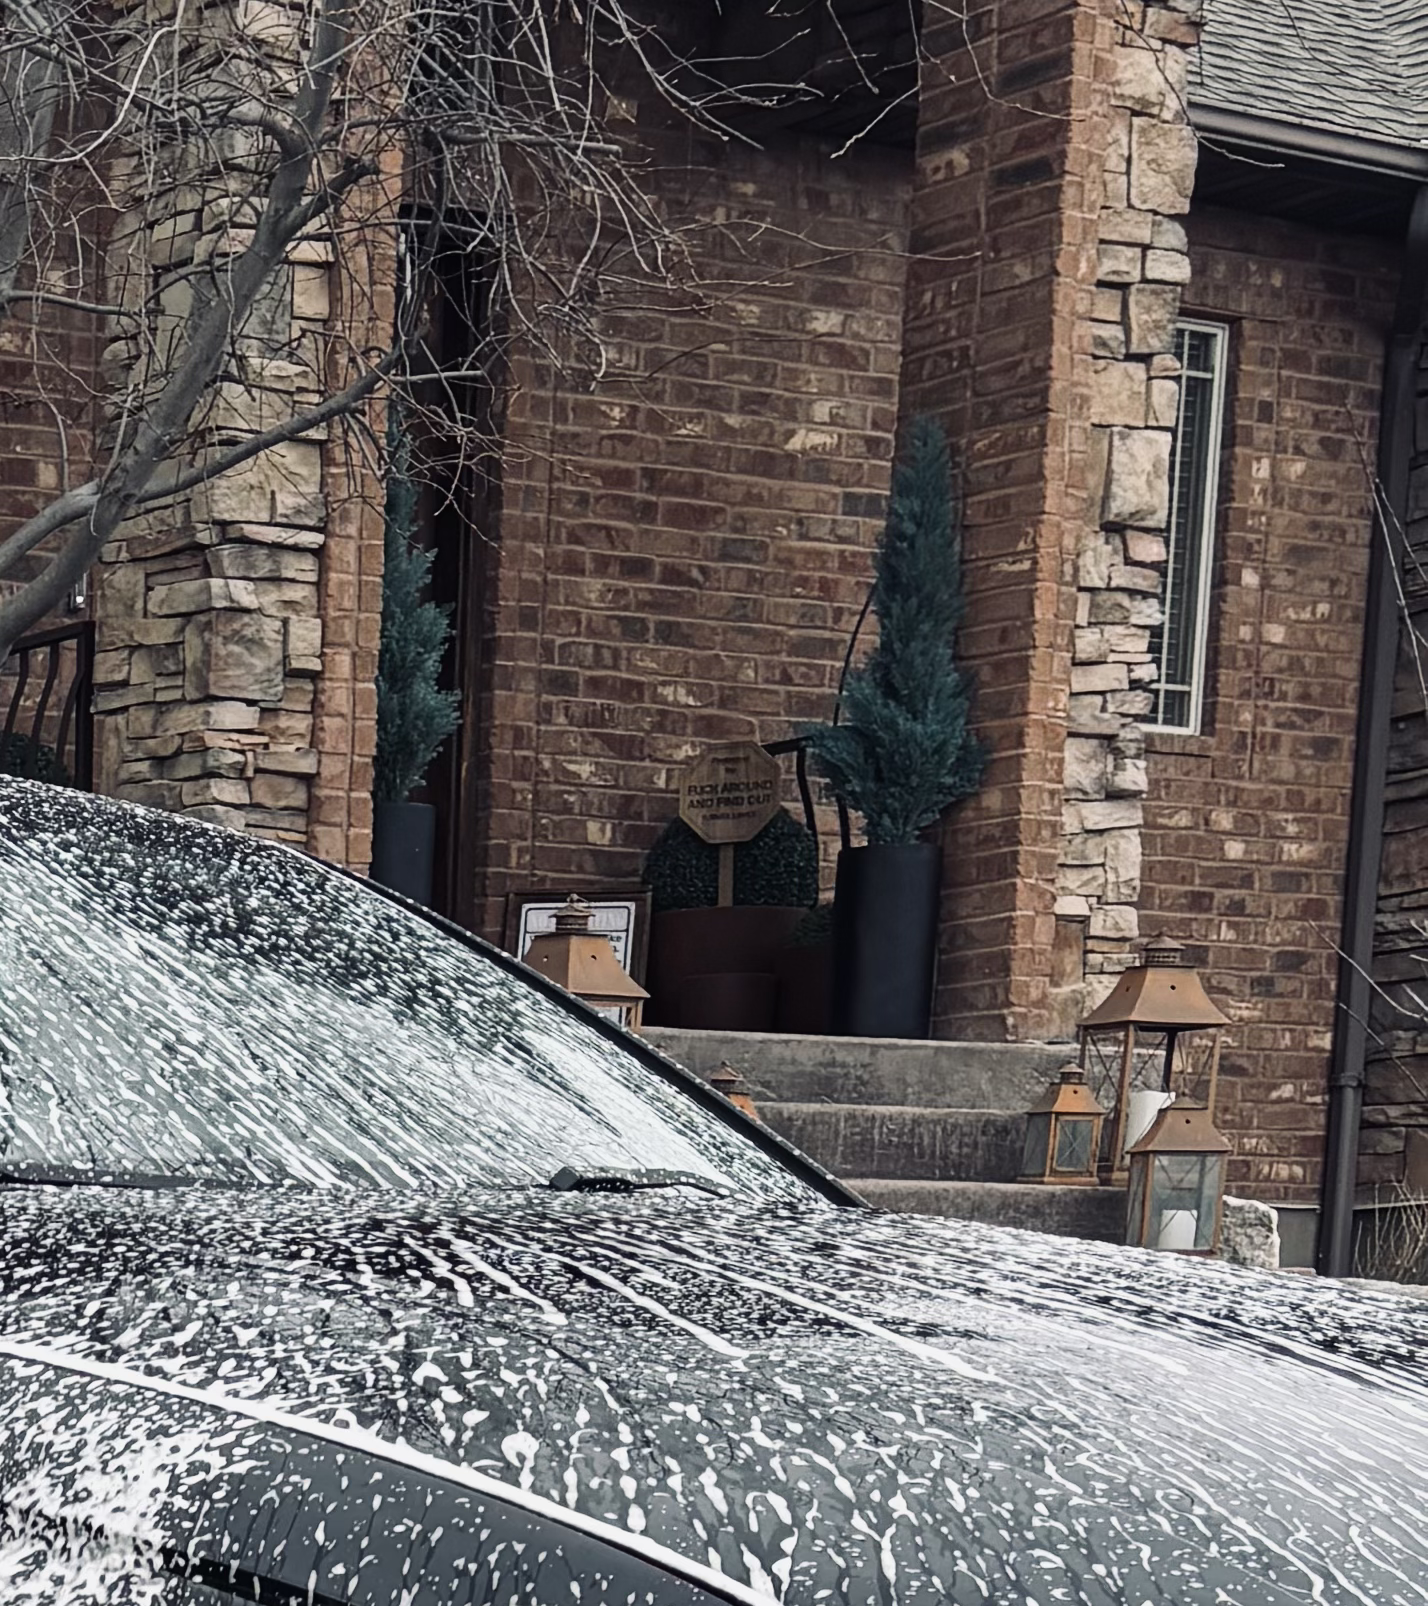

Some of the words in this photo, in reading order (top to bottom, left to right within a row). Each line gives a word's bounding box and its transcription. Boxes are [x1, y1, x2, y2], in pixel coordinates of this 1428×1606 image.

[688, 785, 718, 795] FUCK
[721, 780, 773, 793] AROUND
[688, 798, 713, 809] AND
[717, 796, 744, 807] FIND
[748, 794, 771, 805] OUT
